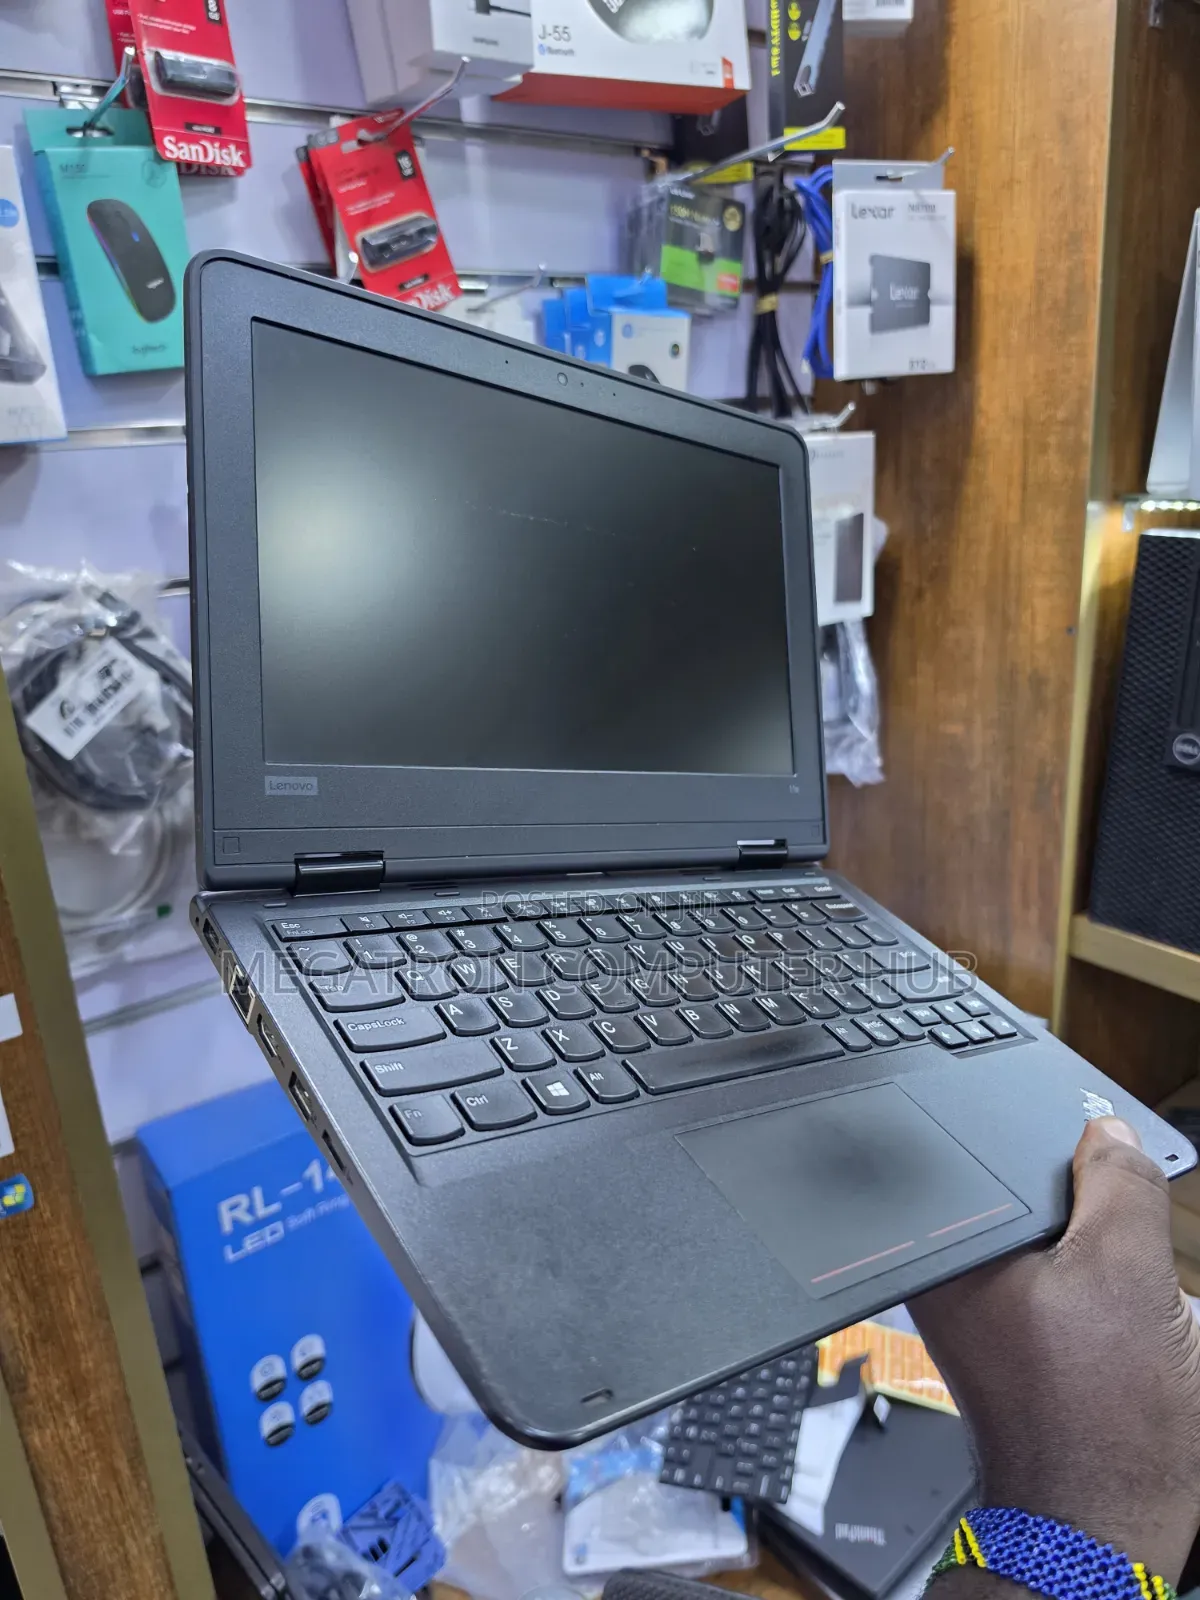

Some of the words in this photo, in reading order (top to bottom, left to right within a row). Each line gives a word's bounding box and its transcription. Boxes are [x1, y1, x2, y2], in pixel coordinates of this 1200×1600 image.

[538, 24, 571, 42] J-55
[162, 135, 247, 168] SanDisk
[851, 202, 896, 219] Lexar
[889, 283, 920, 301] Lexar
[268, 780, 313, 791] Lenovo
[633, 924, 643, 932] 7
[670, 921, 681, 930] 8
[555, 931, 566, 939] 5
[596, 927, 606, 936] 6
[773, 932, 784, 941] P
[406, 934, 418, 942] @
[513, 935, 522, 943] 4
[741, 934, 756, 944] O
[415, 945, 428, 953] 2
[464, 940, 476, 948] 3
[633, 944, 645, 954] Y
[671, 941, 685, 951] U
[363, 951, 374, 960] 1
[550, 953, 567, 963] R
[593, 948, 606, 959] T
[505, 958, 521, 968] E
[780, 961, 794, 971] L
[456, 963, 476, 975] W
[745, 965, 761, 975] K
[406, 970, 424, 981] Q
[673, 974, 689, 984] H
[715, 970, 724, 980] J
[590, 983, 603, 994] F
[634, 978, 650, 989] G
[545, 990, 561, 1001] D
[498, 996, 514, 1008] S
[761, 997, 778, 1008] M
[449, 1004, 463, 1016] A
[724, 1003, 741, 1014] N
[643, 1014, 658, 1026] V
[684, 1009, 700, 1021] B
[347, 1017, 405, 1032] CapsLock
[601, 1021, 616, 1034] C
[551, 1029, 570, 1041] X
[500, 1037, 518, 1050] Z
[374, 1061, 405, 1074] Shift
[589, 1072, 604, 1082] Alt
[466, 1095, 489, 1107] Ctrl
[404, 1109, 422, 1119] Fn
[223, 1220, 285, 1264] LED
